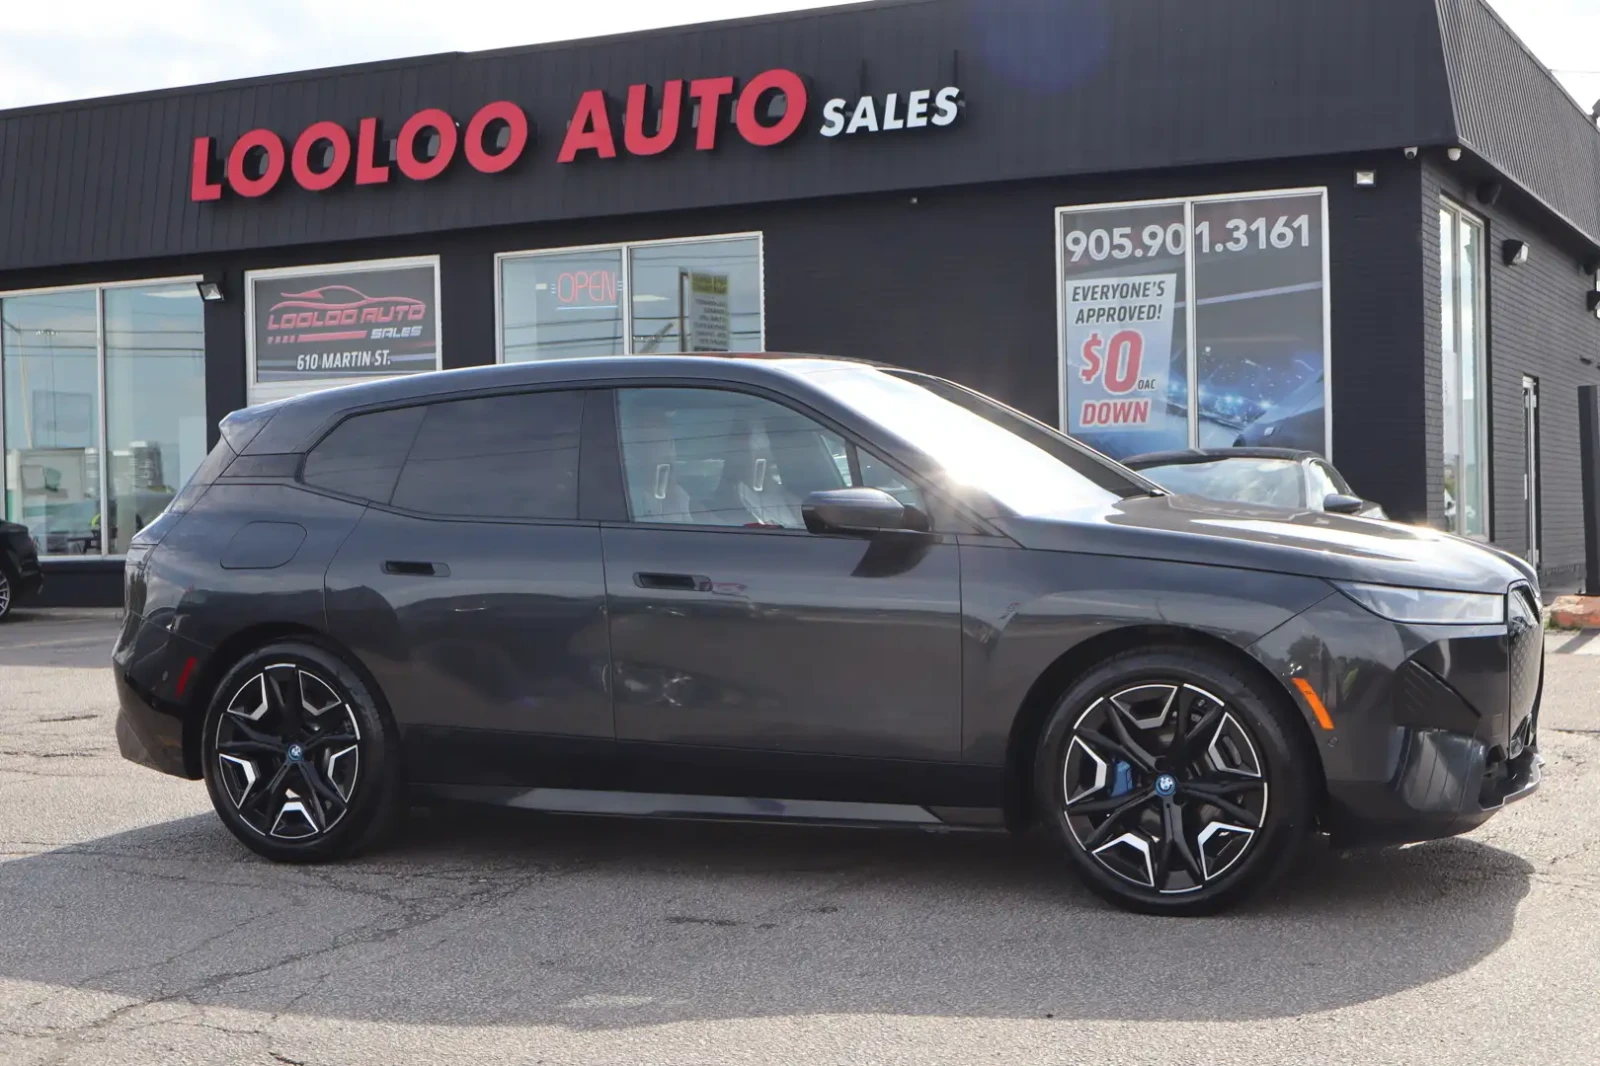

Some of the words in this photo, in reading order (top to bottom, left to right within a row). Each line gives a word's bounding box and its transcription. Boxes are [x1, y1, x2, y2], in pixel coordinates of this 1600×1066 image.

[191, 100, 528, 202] LOOLOO
[556, 68, 808, 164] AUTO
[819, 86, 960, 137] SALES
[1066, 214, 1309, 263] 905.901.3161
[557, 271, 616, 303] OPEN
[1072, 280, 1166, 302] EVERYONE'S
[267, 309, 358, 330] LOOLOO
[360, 305, 426, 324] AUTO
[1075, 303, 1163, 325] APPROVED!
[370, 326, 423, 340] SALES
[297, 354, 319, 371] 610
[321, 350, 373, 369] MARTIN
[374, 349, 391, 366] ST.
[1081, 330, 1143, 393] $0
[1137, 379, 1156, 390] OAC
[1082, 401, 1149, 425] DOWN
